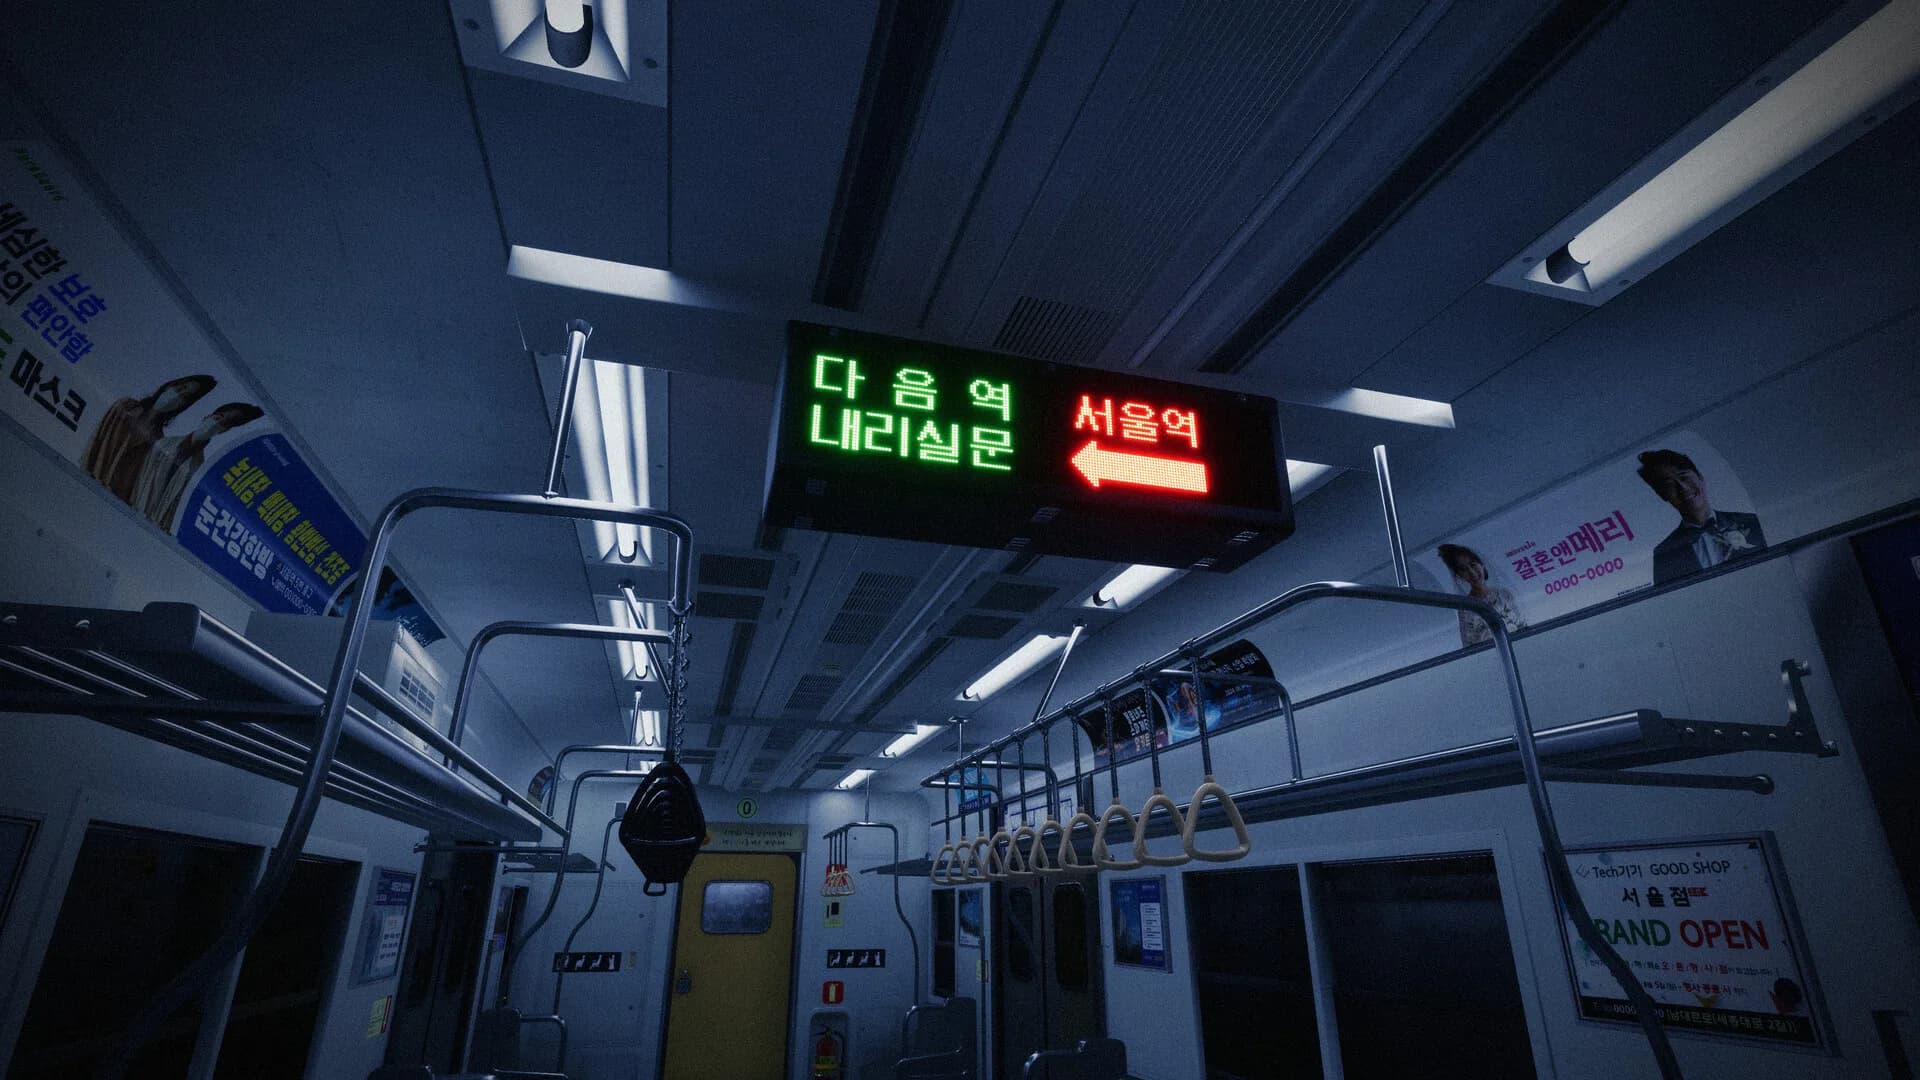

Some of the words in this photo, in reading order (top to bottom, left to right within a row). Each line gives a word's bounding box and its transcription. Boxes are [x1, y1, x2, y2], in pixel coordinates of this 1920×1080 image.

[50, 274, 107, 324] 보호
[21, 294, 94, 364] 편안함
[10, 350, 86, 432] 마스크
[1074, 395, 1199, 448] 서울역
[1511, 510, 1635, 580] 결혼앤메리
[1545, 557, 1624, 595] 0000-0000
[1592, 864, 1642, 878] Tech기기
[1650, 863, 1689, 876] GOOD
[1693, 860, 1730, 875] SHOP
[1592, 918, 1671, 946] RAND
[1679, 919, 1769, 950] OPEN
